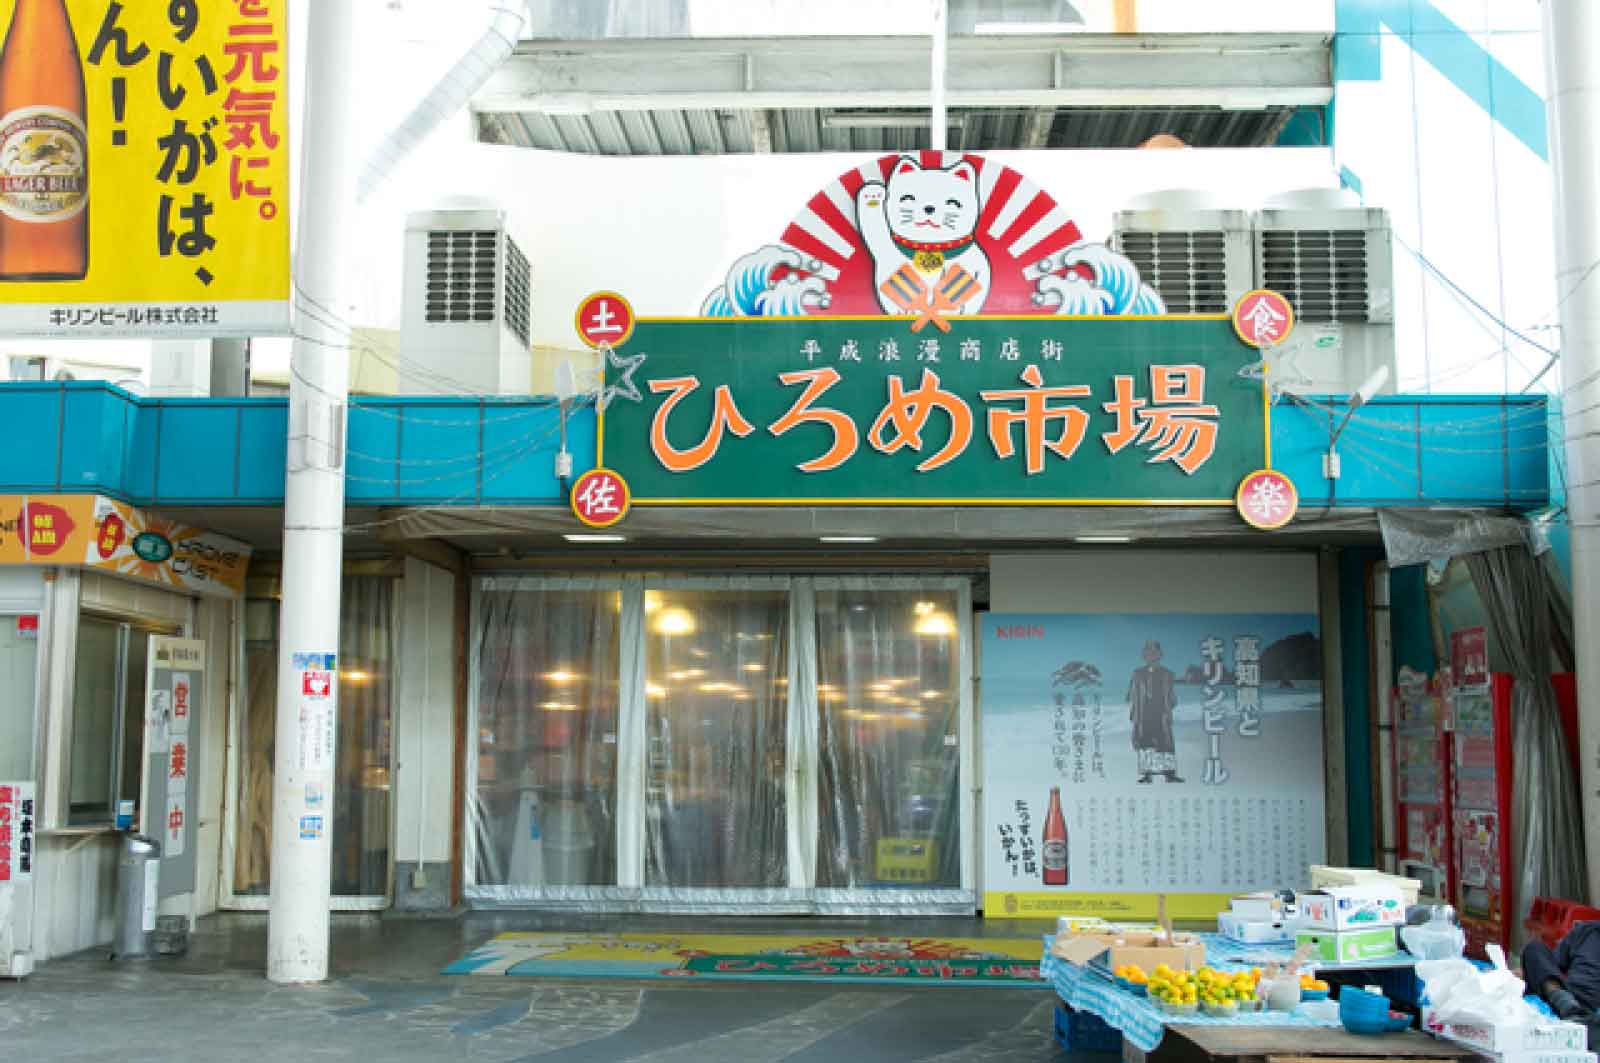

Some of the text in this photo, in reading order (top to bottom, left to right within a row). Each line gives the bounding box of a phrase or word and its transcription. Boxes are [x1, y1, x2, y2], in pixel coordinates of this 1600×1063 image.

[50, 306, 219, 326] キリンビール株式会社
[586, 300, 623, 334] 土
[1242, 296, 1286, 337] 食
[799, 337, 1065, 363] 平成浪漫商店街
[647, 363, 1221, 476] ひろめ市場
[577, 477, 619, 515] 佐
[1249, 477, 1288, 517] 楽
[996, 624, 1044, 640] KIRIN
[1200, 636, 1229, 785] キリンビール
